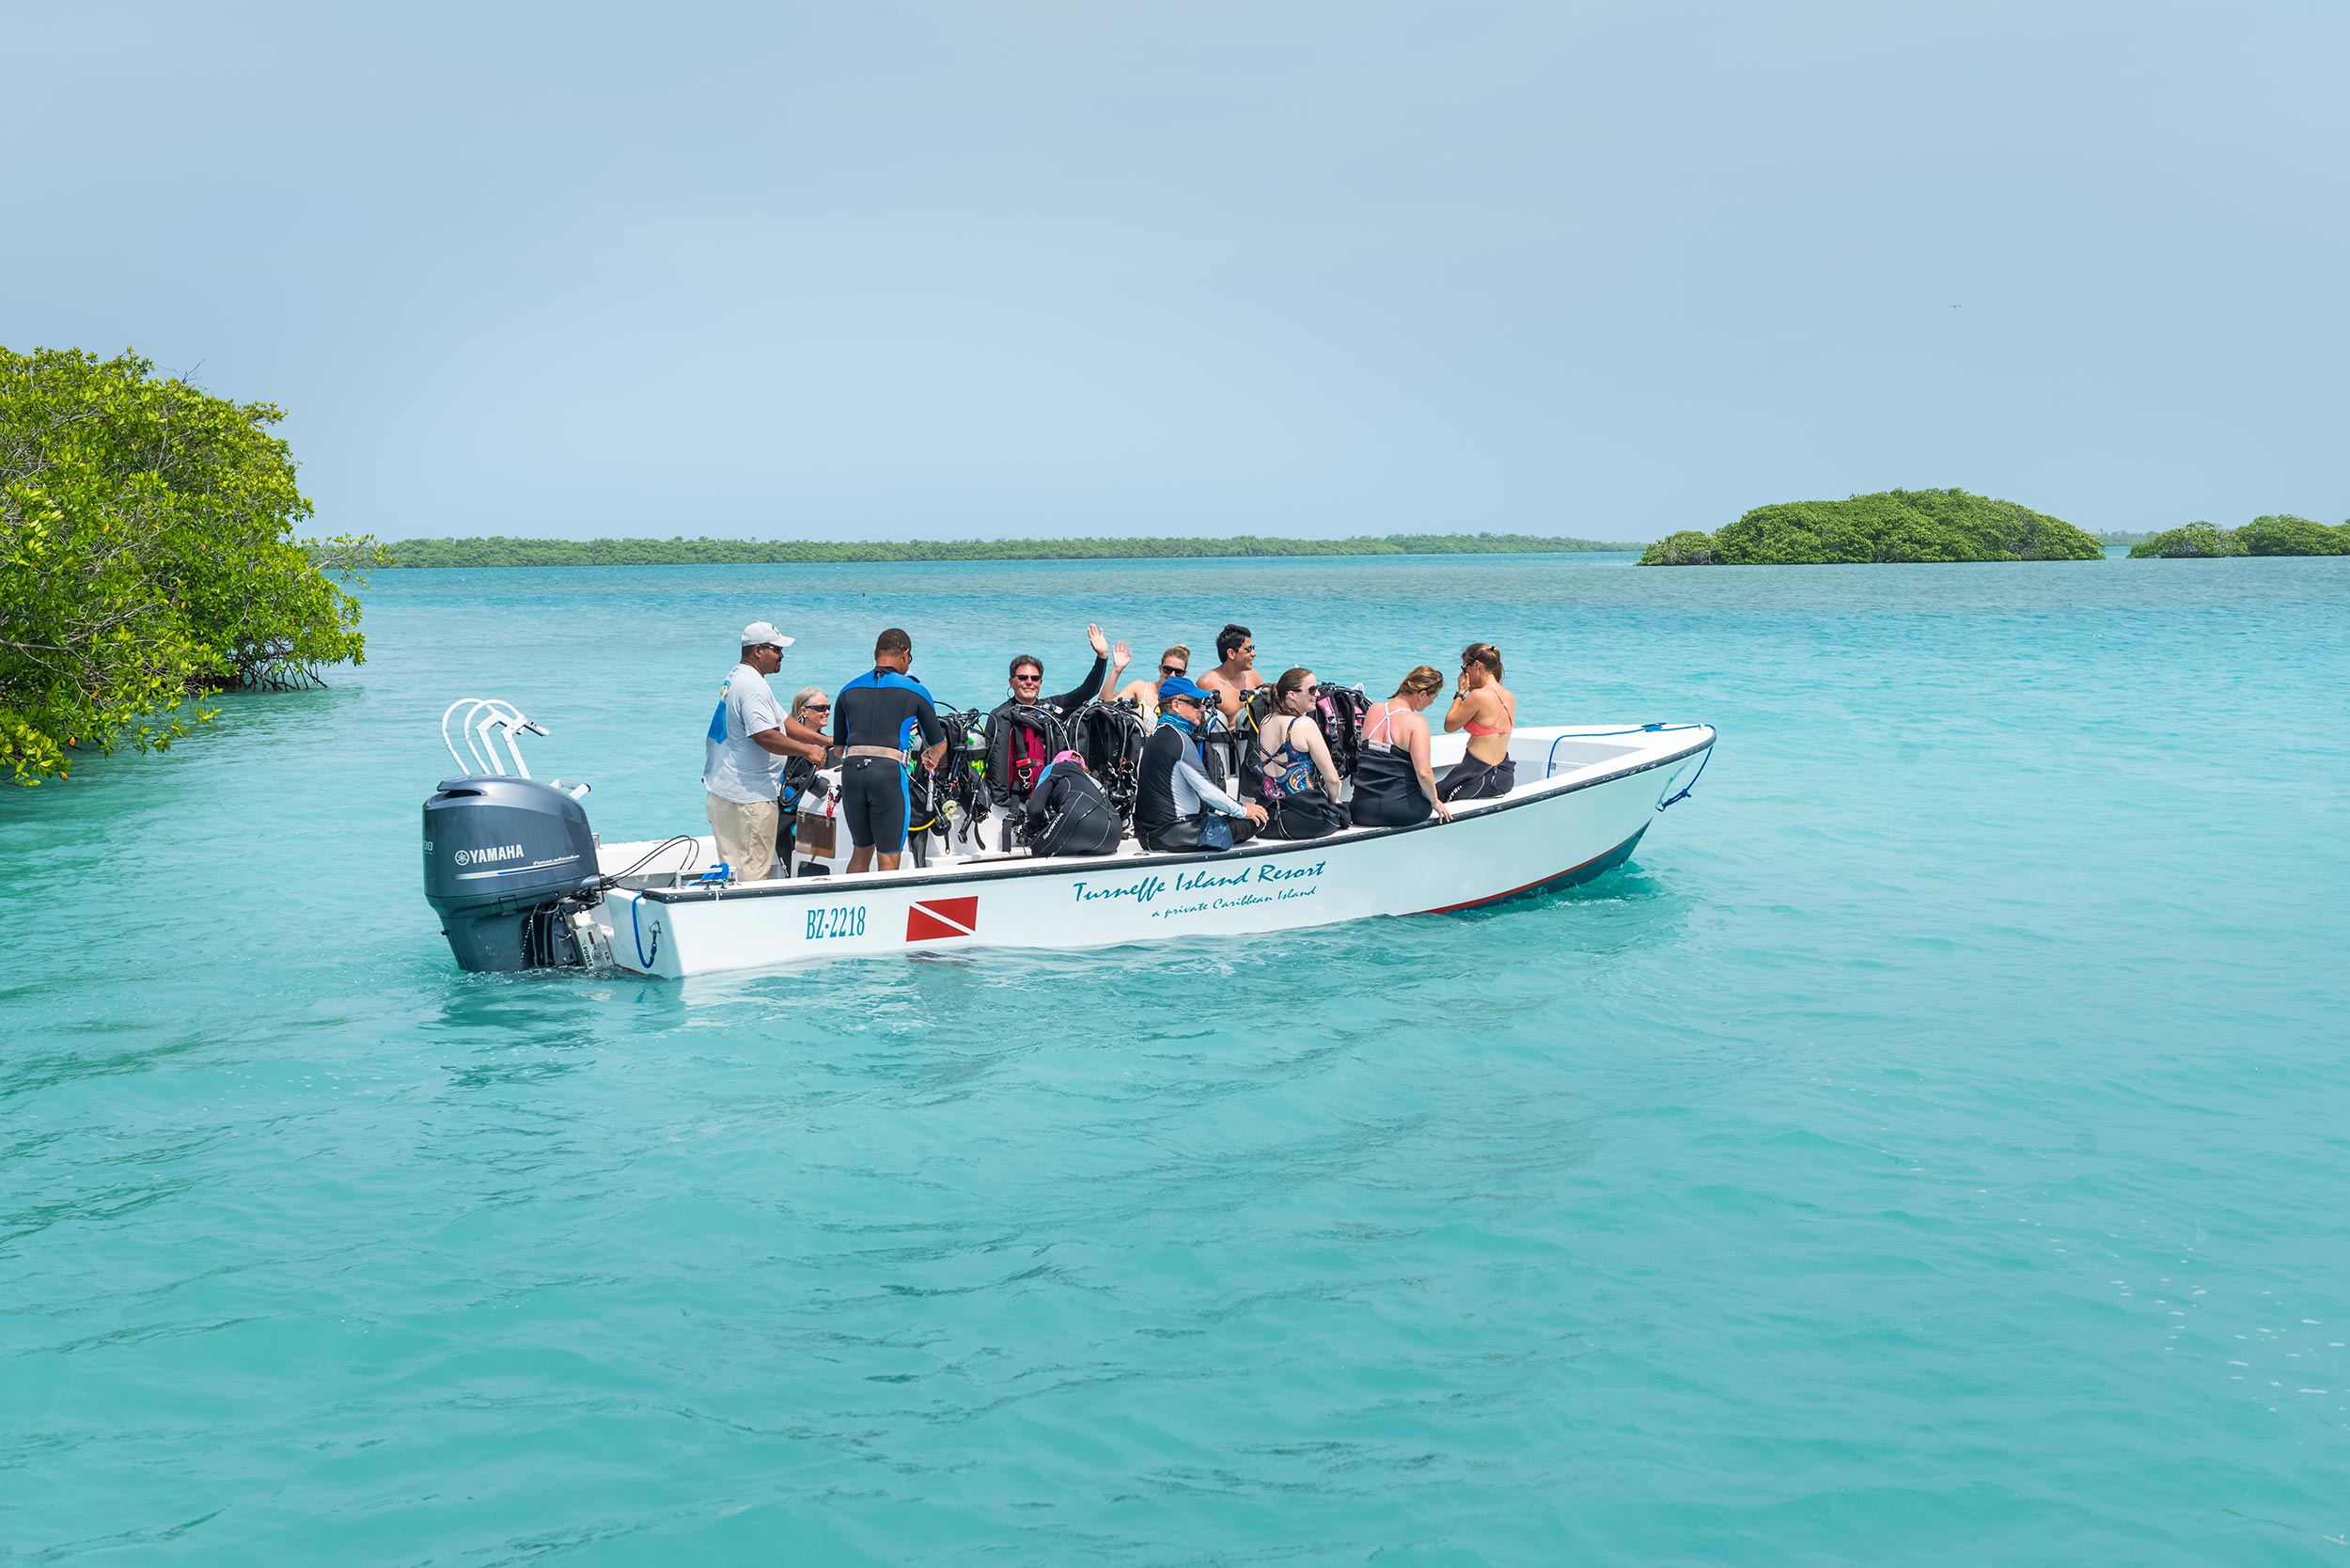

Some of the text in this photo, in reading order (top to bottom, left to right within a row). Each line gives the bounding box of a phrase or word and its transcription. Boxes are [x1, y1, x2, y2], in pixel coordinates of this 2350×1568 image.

[470, 844, 525, 863] YAMAHA
[1073, 860, 1326, 902] Turneffe Island Resort
[1164, 902, 1208, 918] private
[1213, 894, 1273, 909] Caribbean
[1277, 886, 1317, 900] Island
[806, 905, 866, 940] BZ-2218
